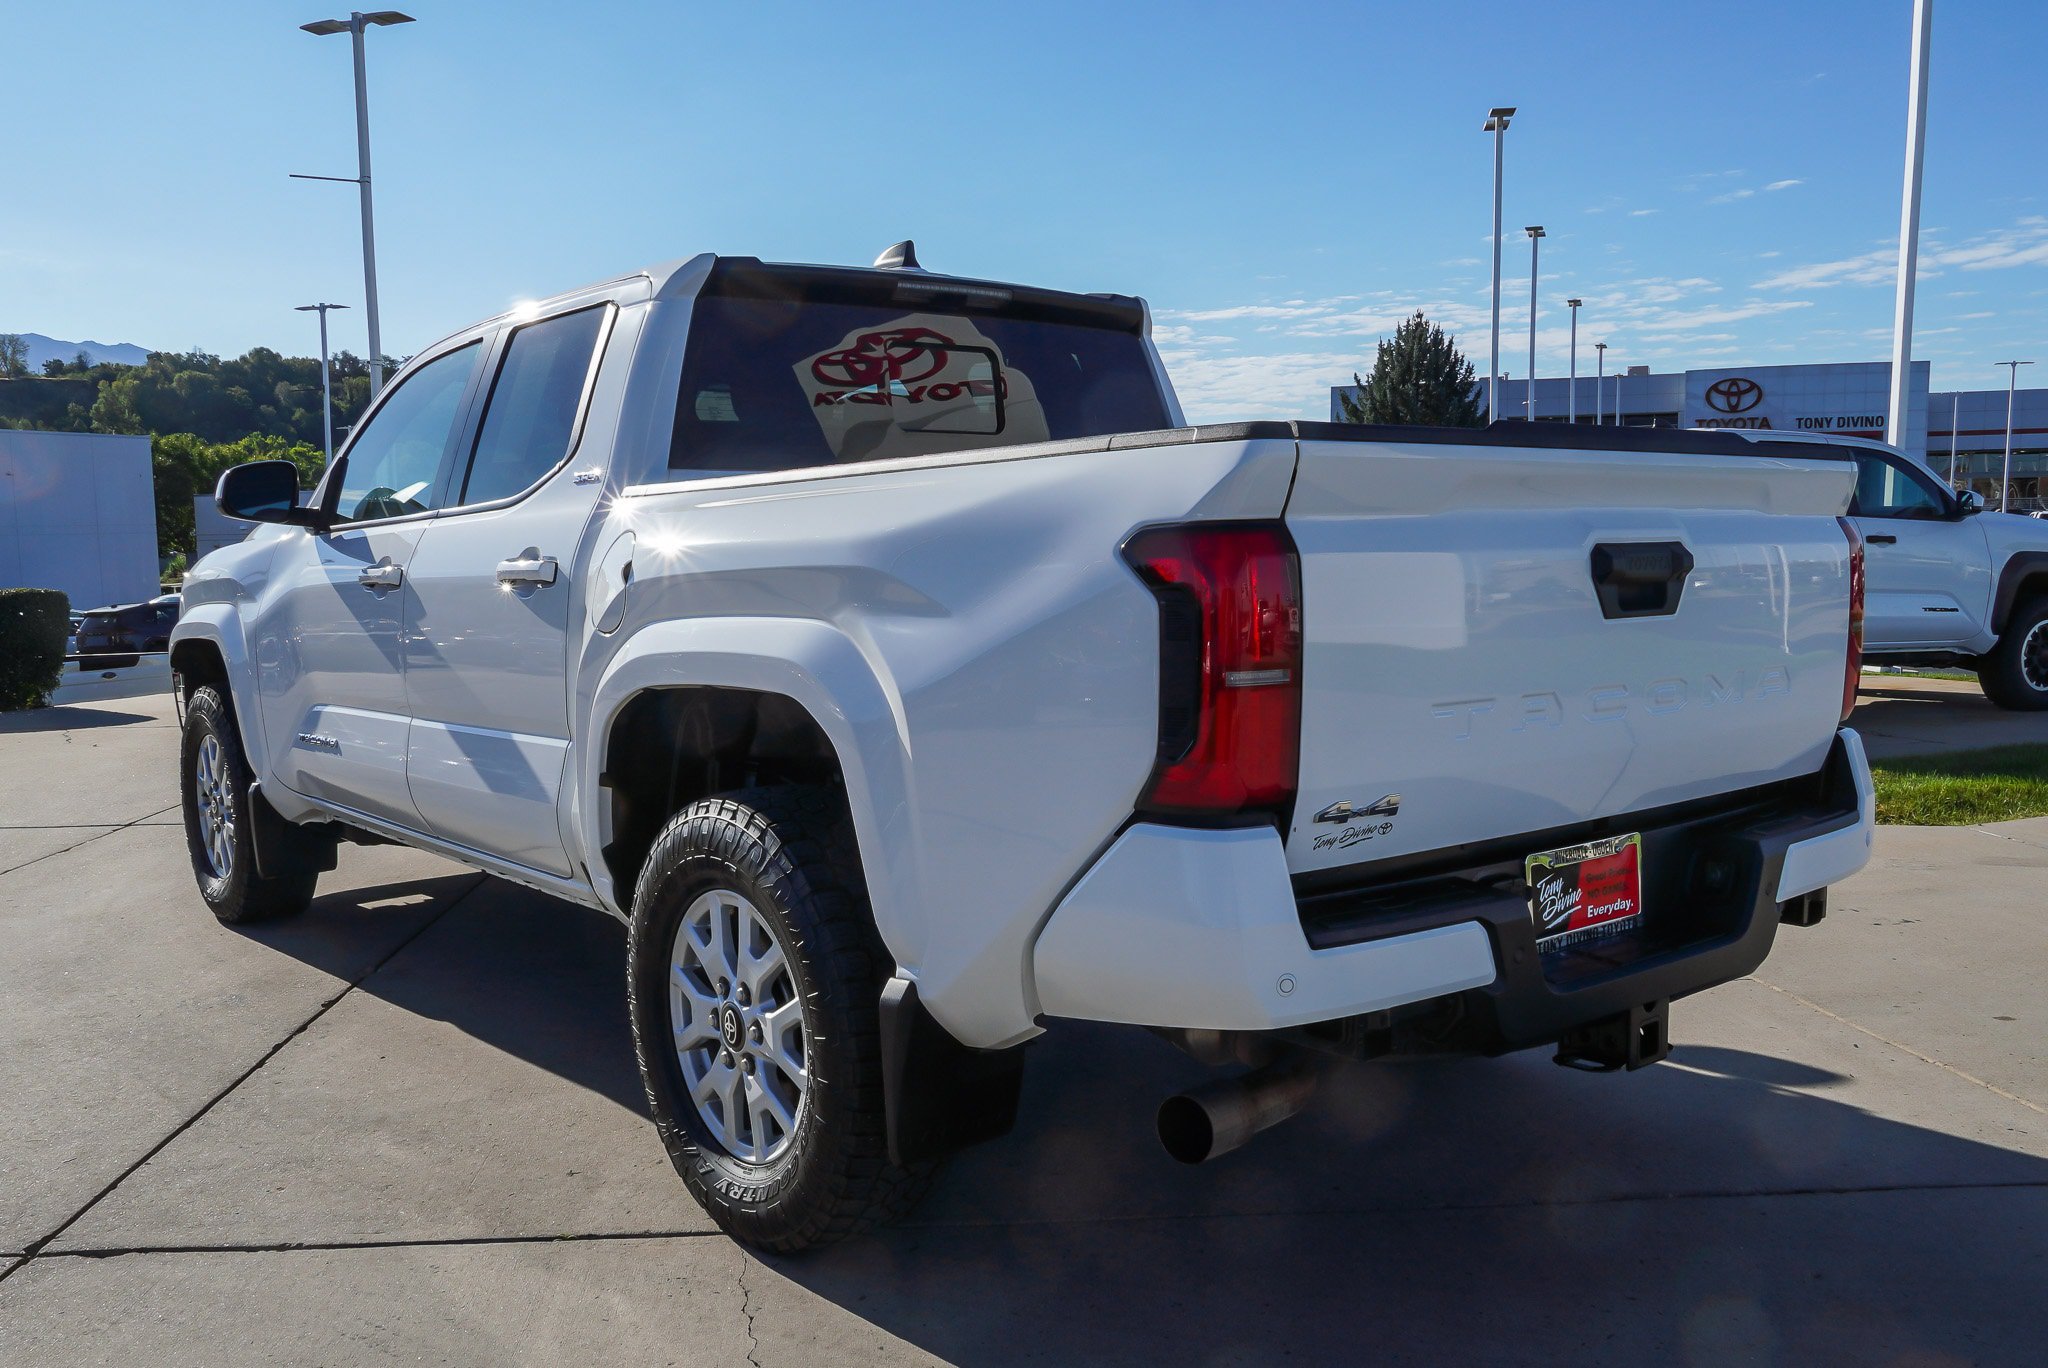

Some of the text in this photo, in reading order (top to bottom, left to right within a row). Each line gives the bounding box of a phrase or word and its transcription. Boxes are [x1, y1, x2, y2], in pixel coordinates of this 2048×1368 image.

[1695, 417, 1772, 430] TOYOTA
[1796, 416, 1885, 429] TONY DIVINO
[1431, 665, 1792, 740] TACOMA
[1312, 824, 1377, 851] Tony Divino
[1537, 873, 1564, 902] Tony
[1539, 887, 1582, 921] Divino
[1587, 898, 1634, 918] Everyday.
